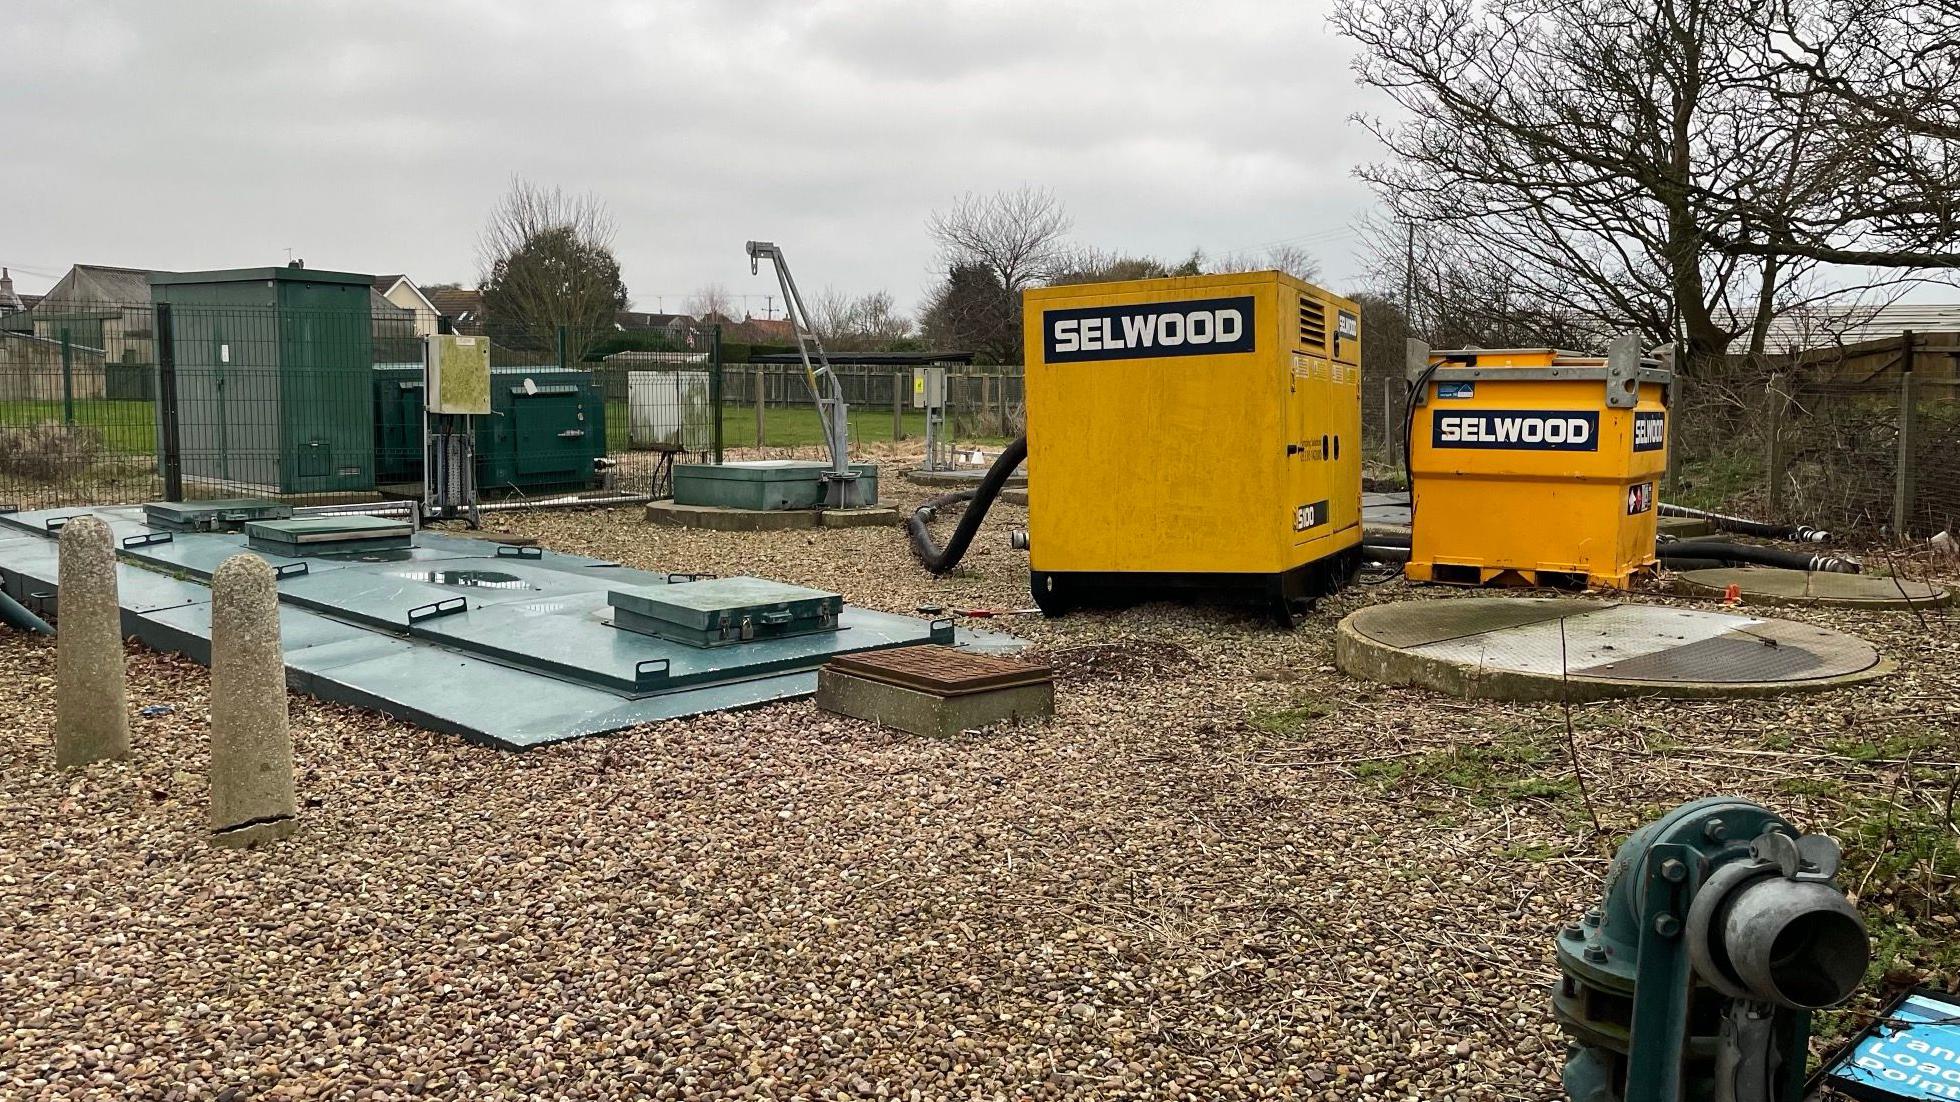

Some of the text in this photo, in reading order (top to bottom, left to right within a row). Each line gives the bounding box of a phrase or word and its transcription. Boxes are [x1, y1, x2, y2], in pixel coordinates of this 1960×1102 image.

[1054, 309, 1243, 352] SELWOOD
[1339, 315, 1357, 337] SELWOOD
[1441, 417, 1589, 444] SELWOOD
[1635, 419, 1664, 445] SELWOOD
[1887, 1028, 1960, 1065] Tan
